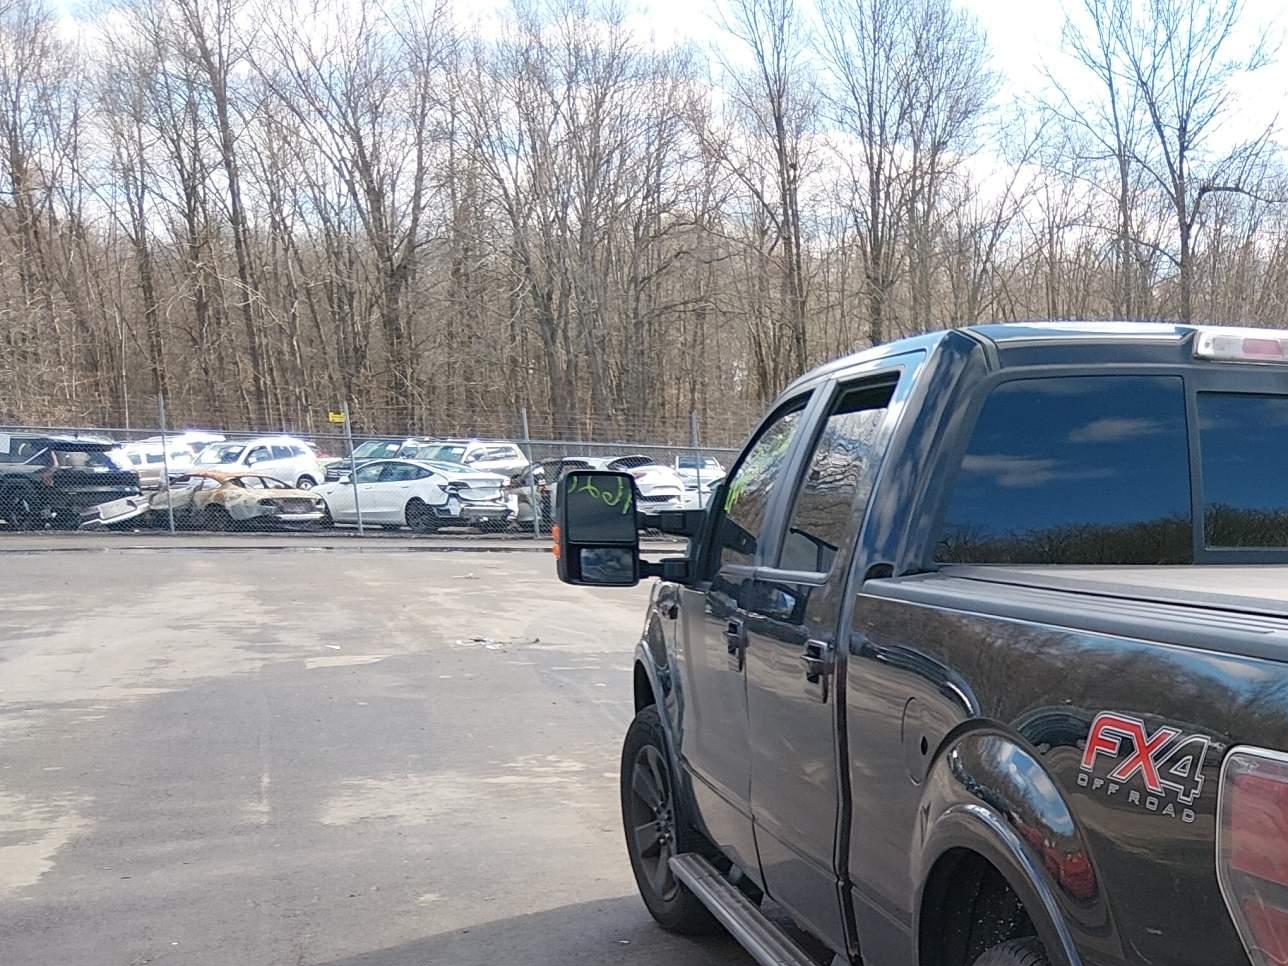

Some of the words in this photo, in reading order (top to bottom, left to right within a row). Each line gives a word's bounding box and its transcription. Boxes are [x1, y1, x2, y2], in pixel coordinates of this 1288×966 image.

[1080, 711, 1211, 805] FX4
[1077, 773, 1120, 795] OFF
[1128, 790, 1196, 823] ROAD
